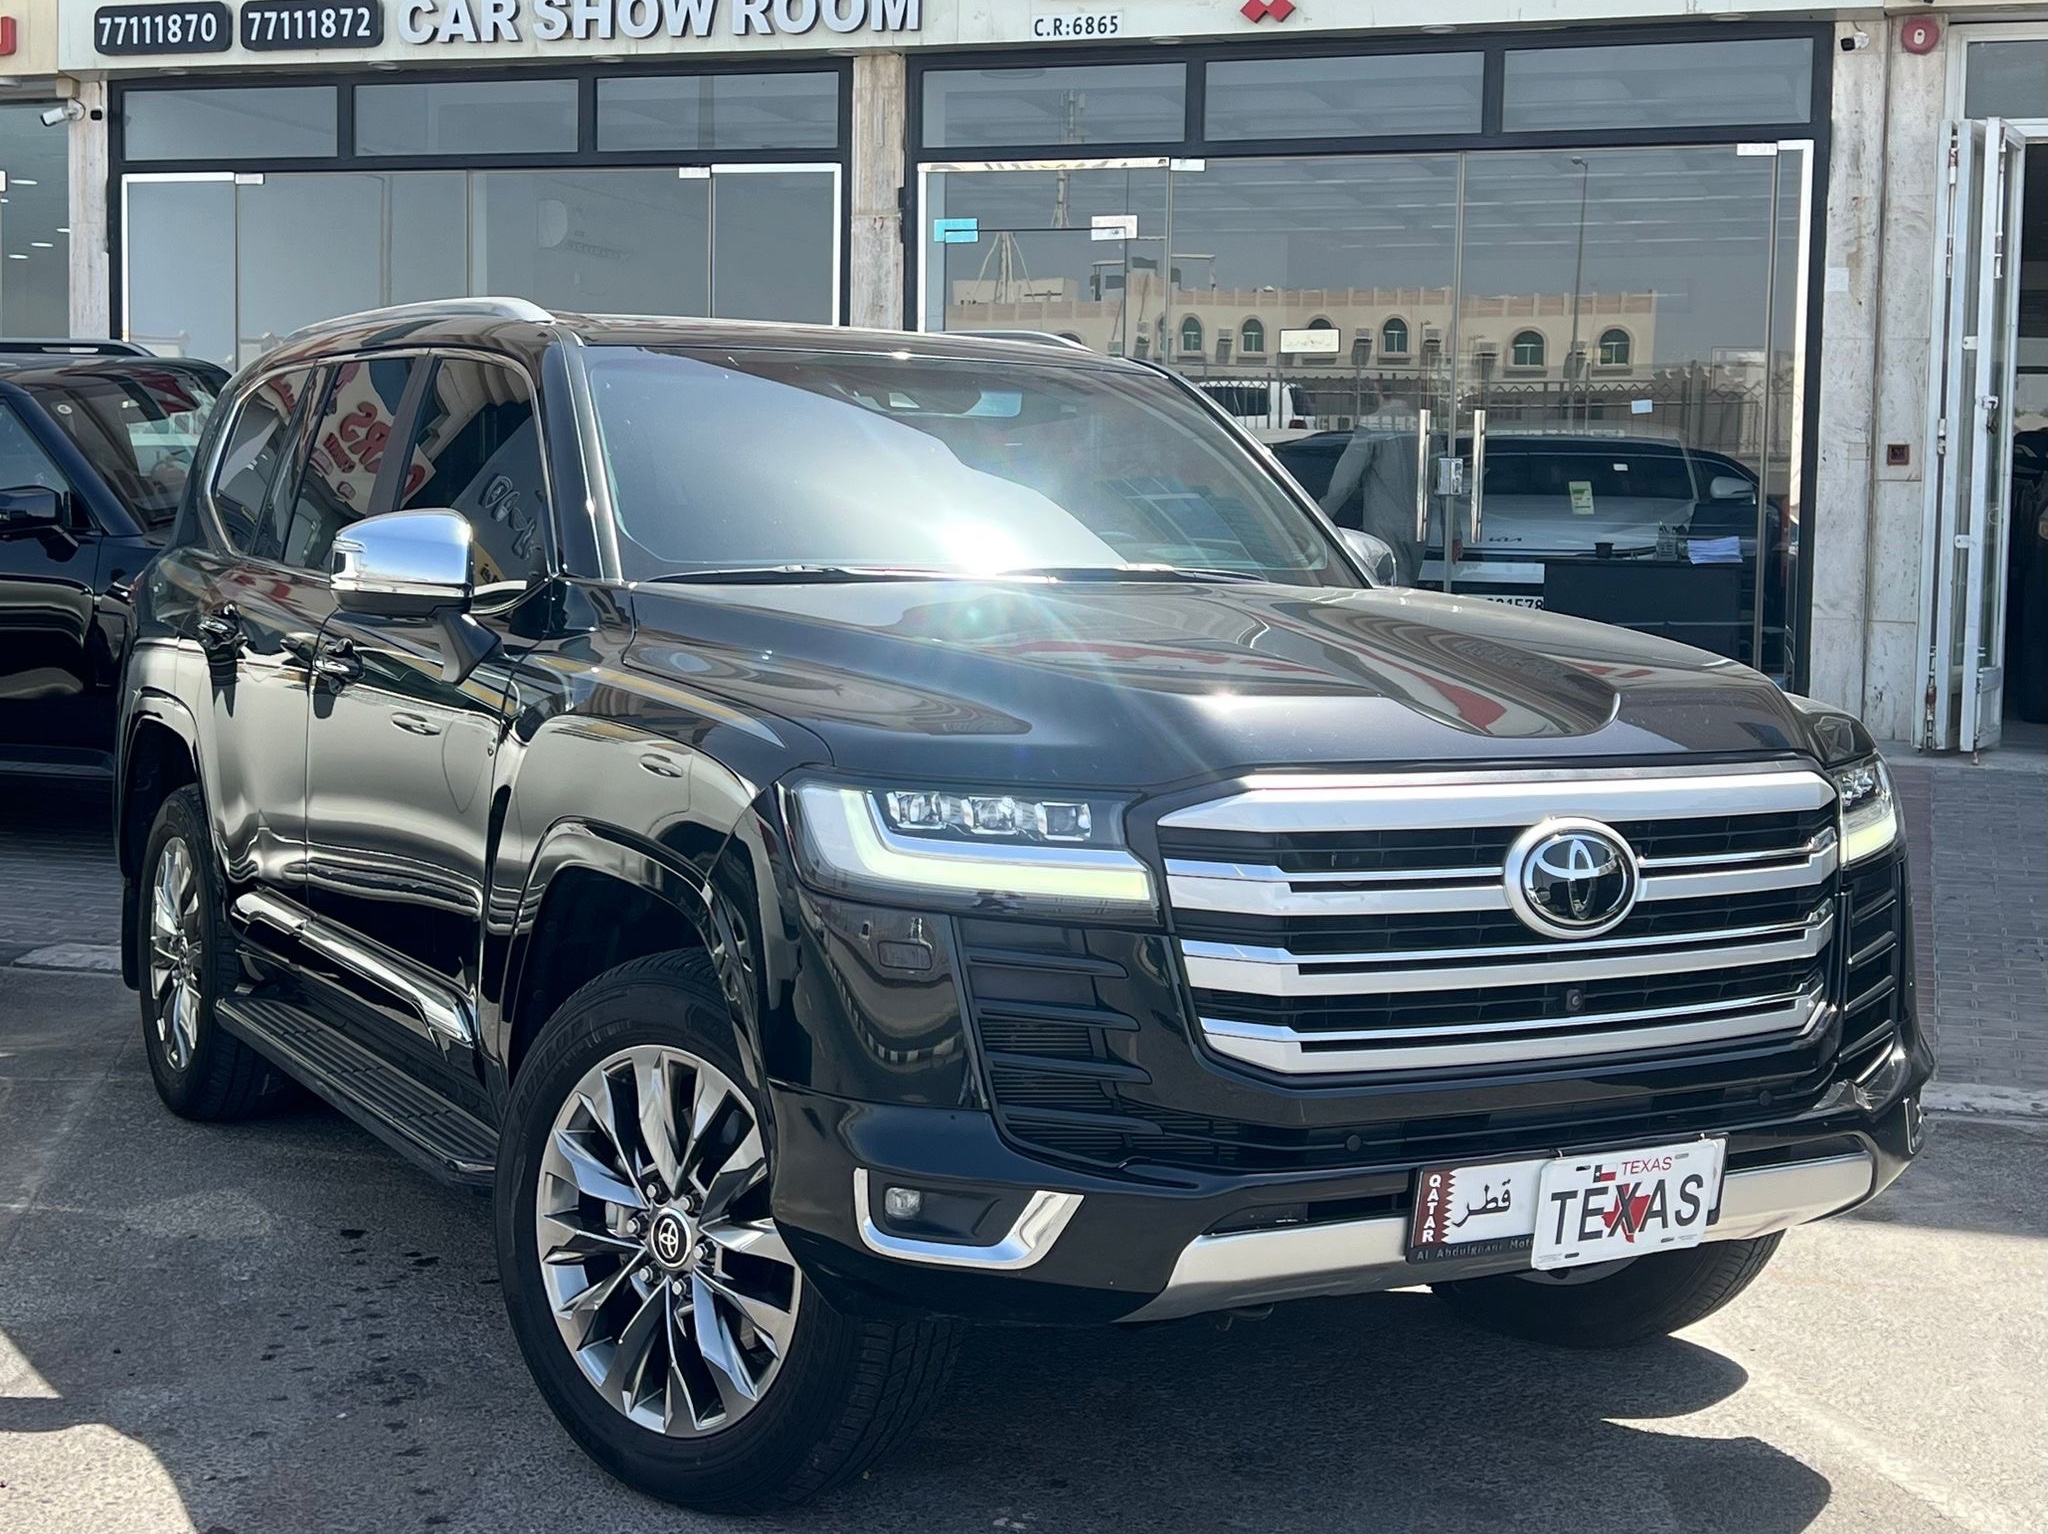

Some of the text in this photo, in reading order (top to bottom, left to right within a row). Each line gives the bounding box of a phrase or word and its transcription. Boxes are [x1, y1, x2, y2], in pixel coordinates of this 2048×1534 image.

[99, 13, 218, 46] 77111870
[248, 7, 371, 41] 77111872
[398, 0, 921, 44] CAR SHOW ROOM
[1034, 15, 1118, 37] C.R:6865
[1621, 1156, 1673, 1176] TEXAS
[1422, 1174, 1442, 1243] QATAR
[1451, 1178, 1511, 1228] قطر
[1551, 1173, 1704, 1245] TEXAS
